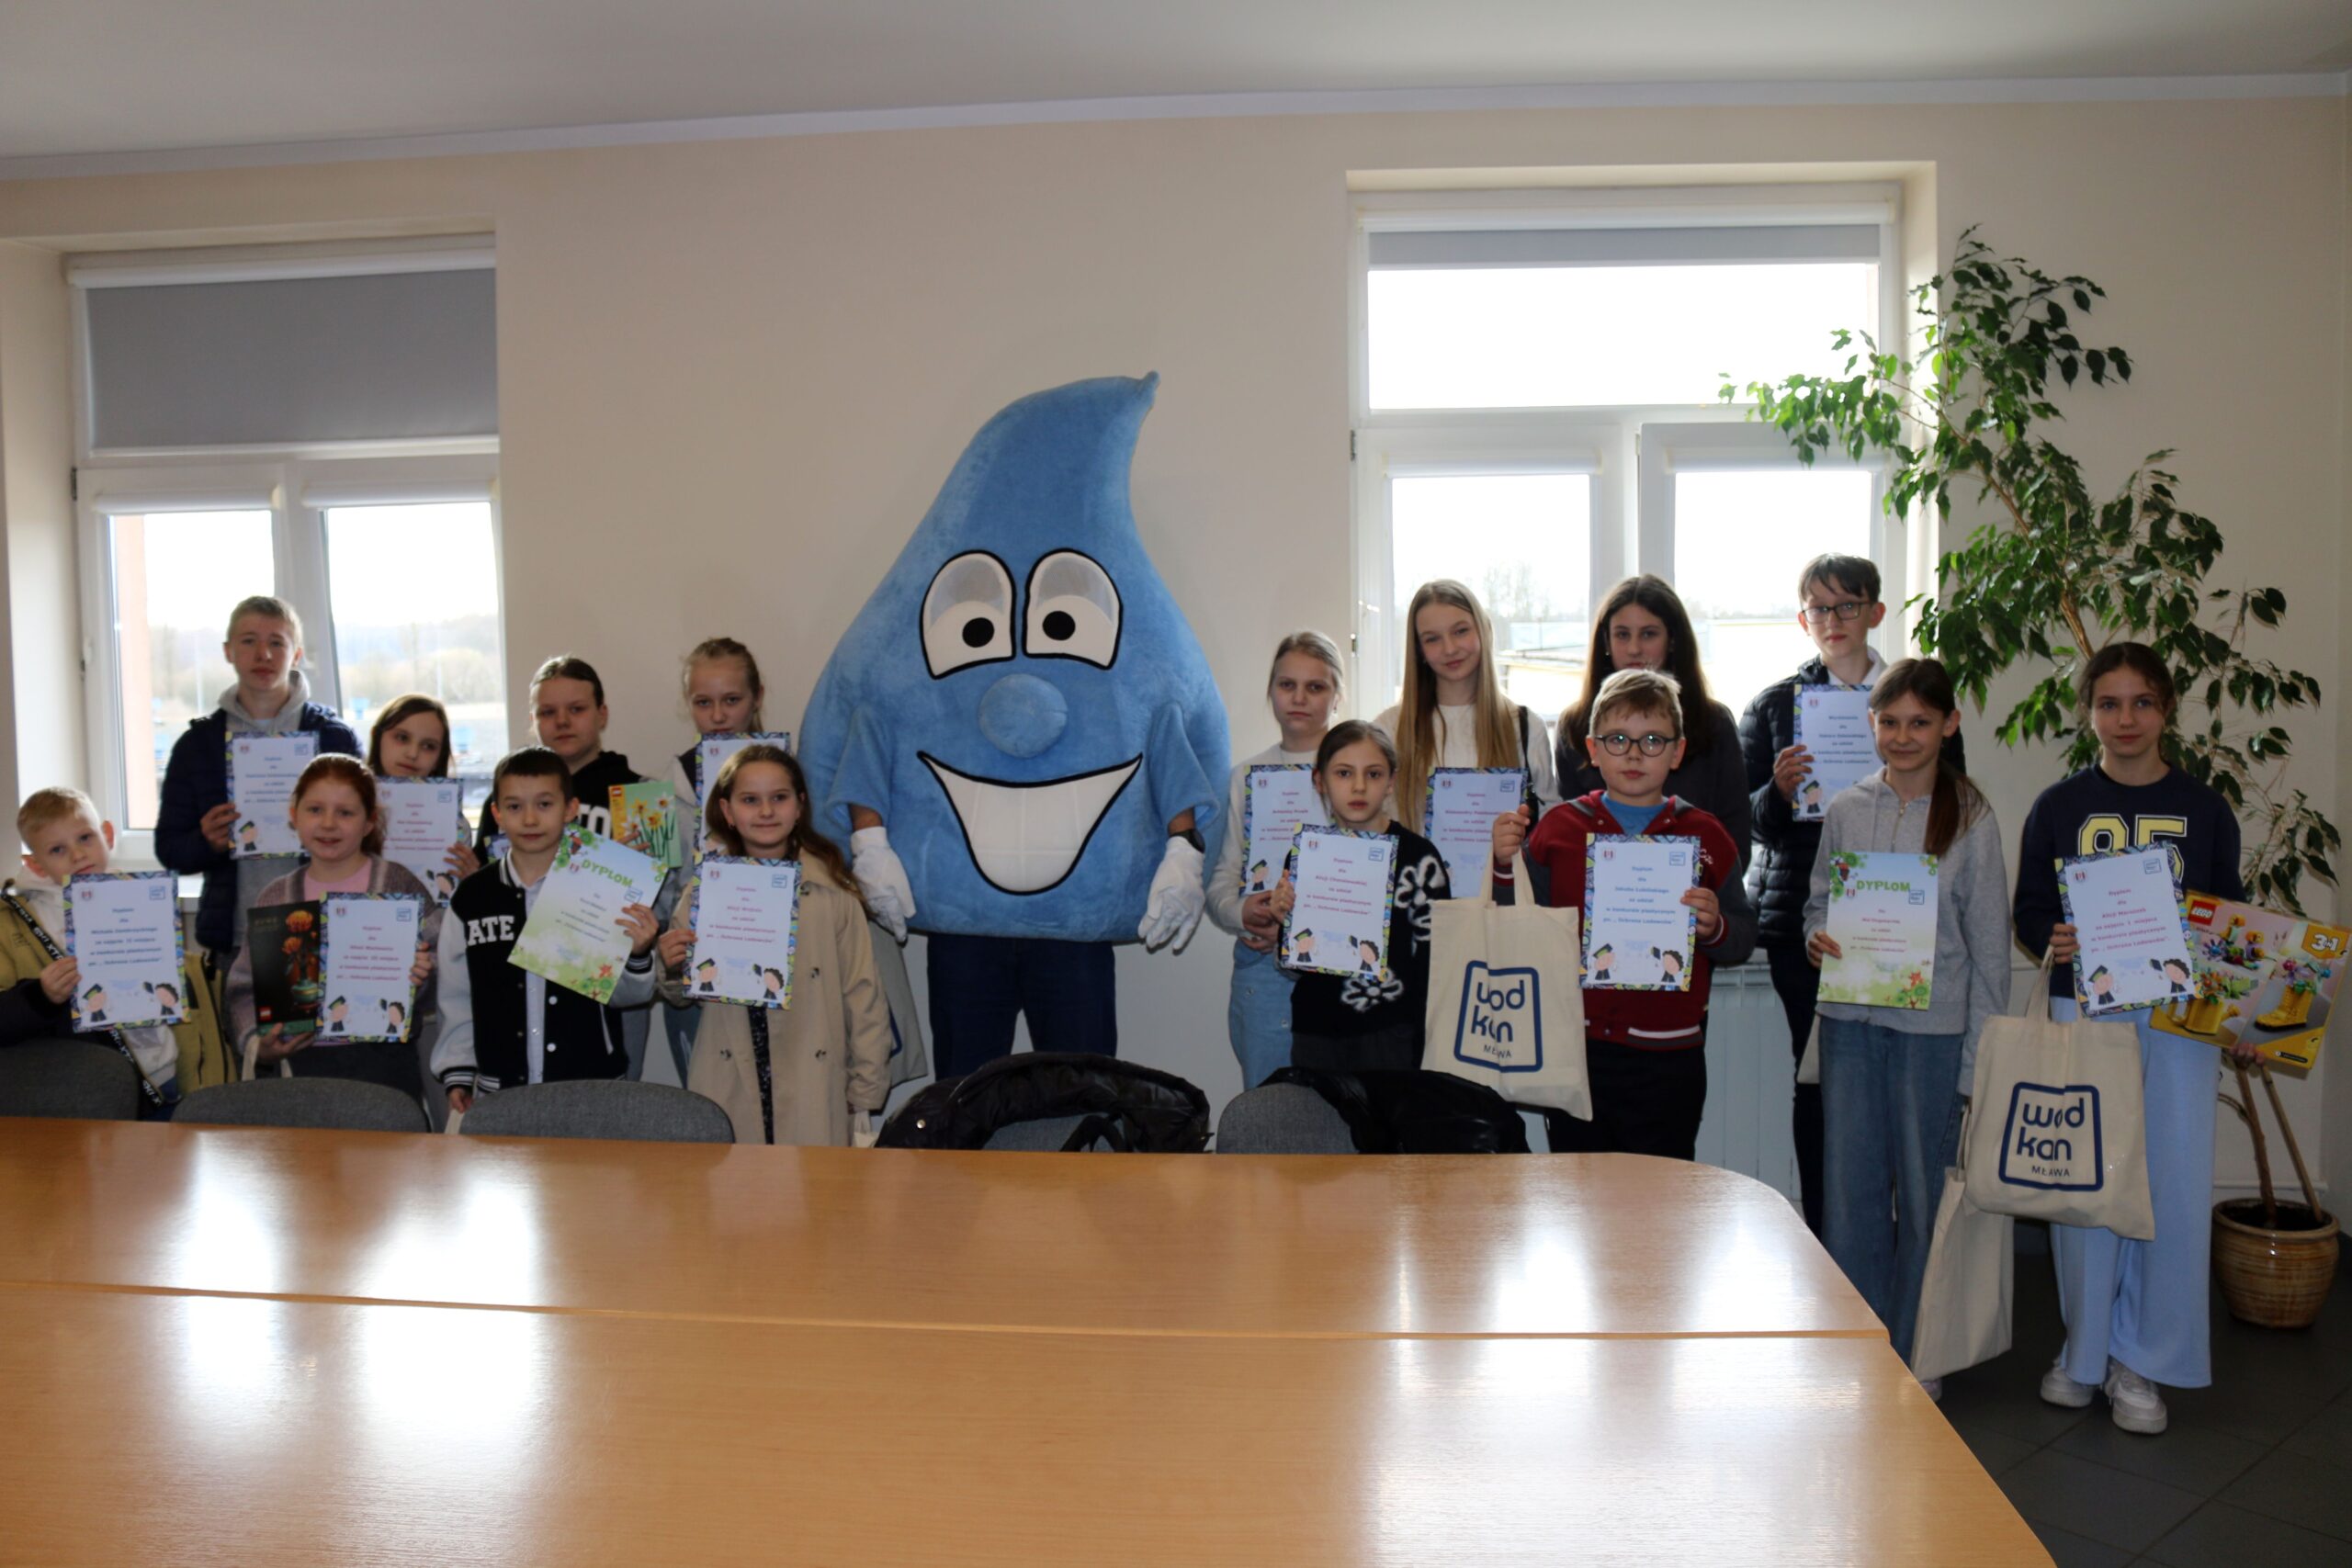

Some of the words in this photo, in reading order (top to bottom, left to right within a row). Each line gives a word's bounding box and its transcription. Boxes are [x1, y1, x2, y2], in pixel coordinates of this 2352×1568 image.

[582, 859, 633, 887] DYPLOM
[1856, 880, 1911, 892] DYPLOM
[2191, 906, 2213, 918] LEGO
[467, 915, 514, 946] ATE
[2017, 1126, 2073, 1161] kan
[2031, 1165, 2070, 1177] MŁAWA
